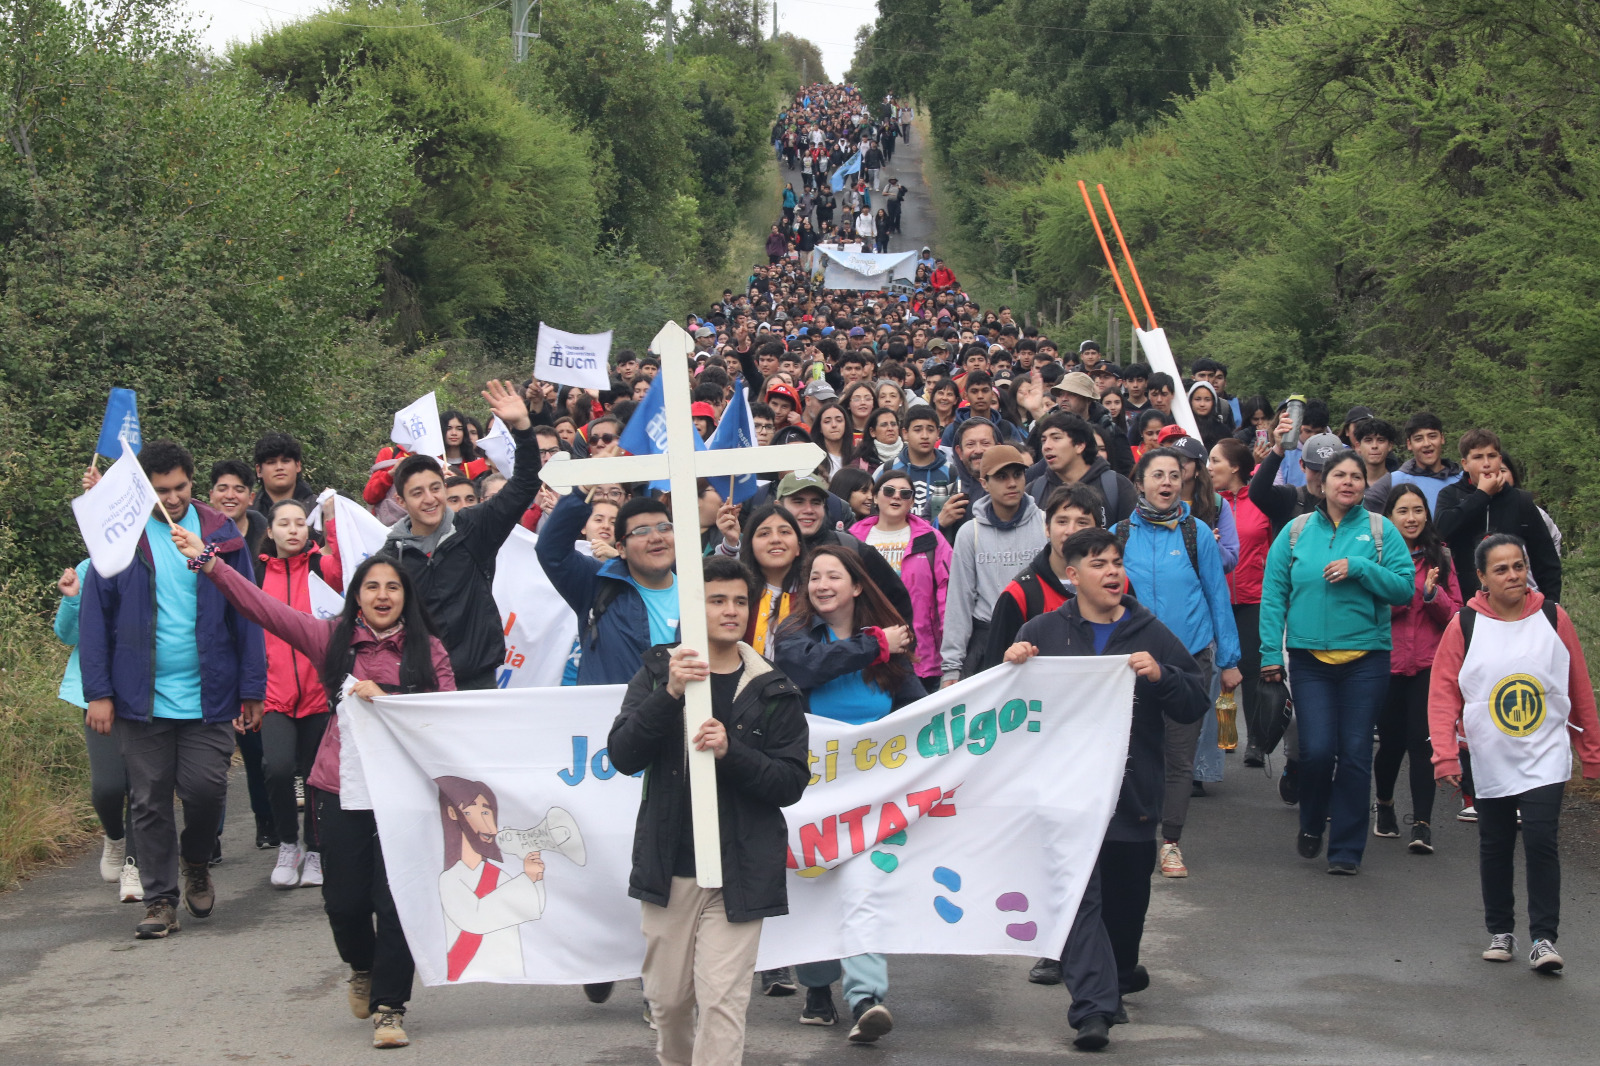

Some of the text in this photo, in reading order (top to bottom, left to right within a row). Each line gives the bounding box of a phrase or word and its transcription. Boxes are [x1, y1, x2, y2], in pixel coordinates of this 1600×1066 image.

[852, 734, 907, 771] te
[916, 698, 1042, 756] digo:
[498, 831, 512, 845] NO
